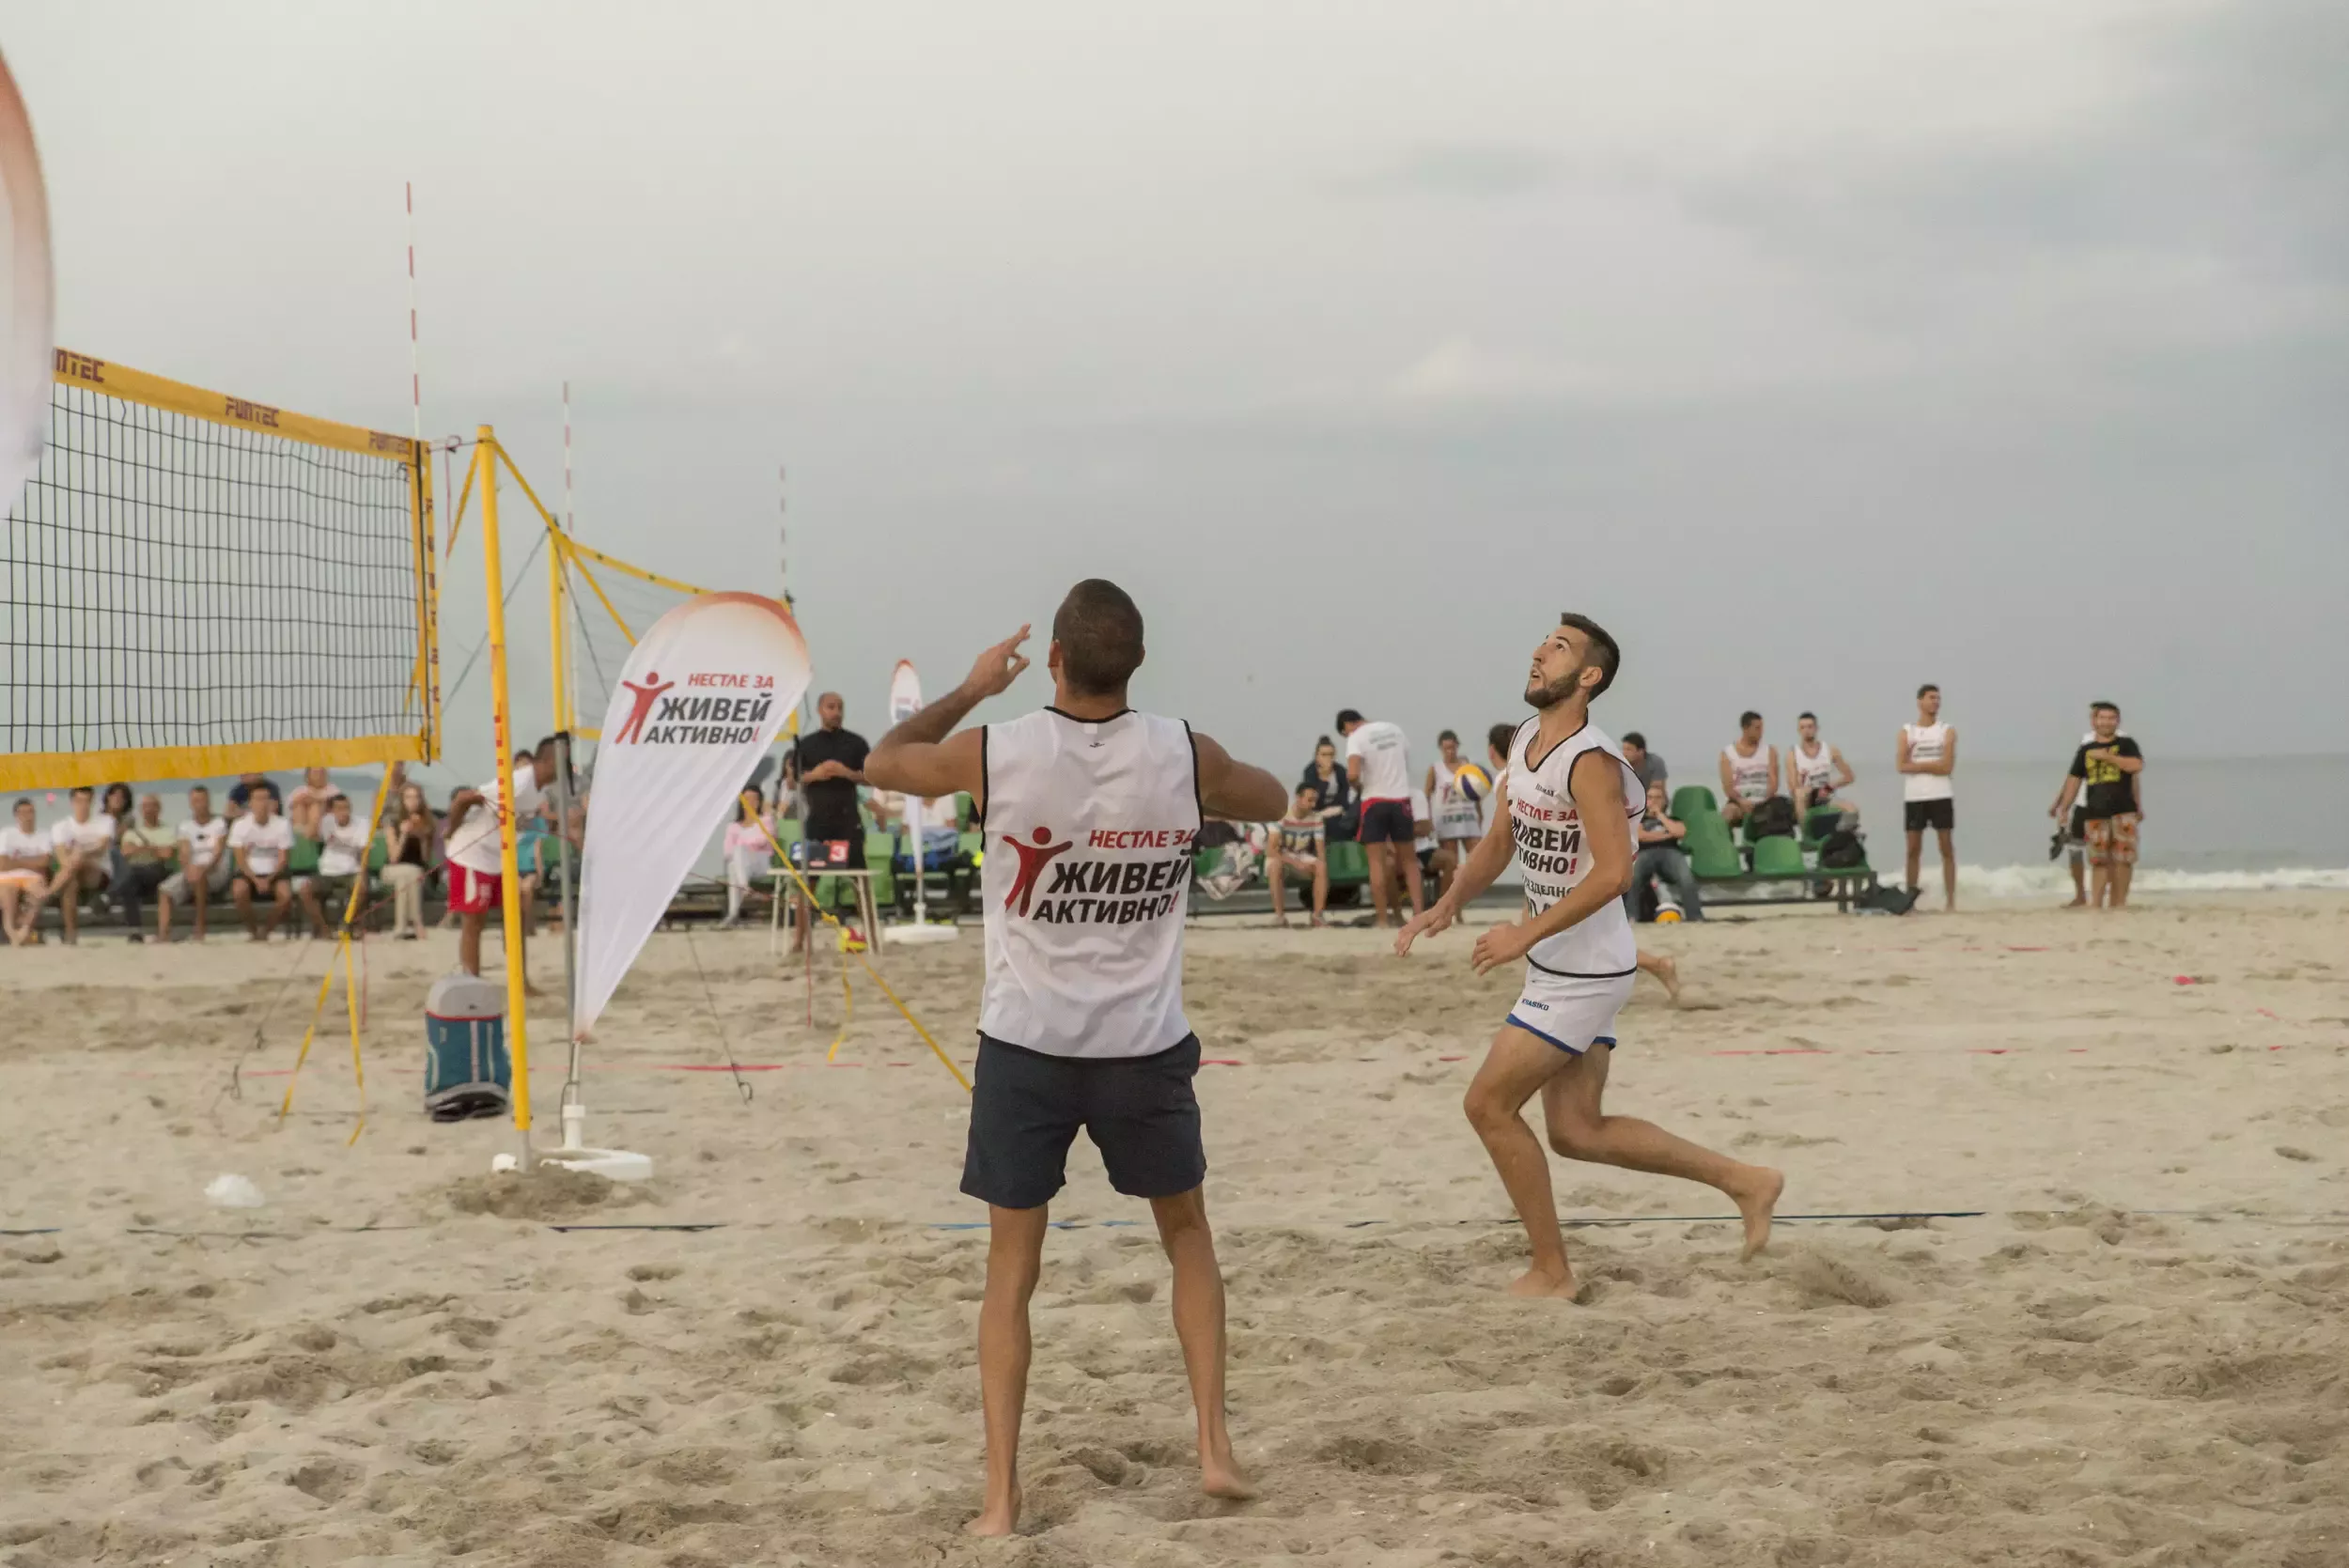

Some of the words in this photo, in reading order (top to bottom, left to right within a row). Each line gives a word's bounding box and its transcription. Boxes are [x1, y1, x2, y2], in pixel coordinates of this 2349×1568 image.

[56, 349, 105, 384] NTEC
[226, 396, 279, 428] FUNTEC
[687, 673, 748, 688] НЕСТЛЕ
[753, 675, 774, 689] ЗА
[657, 692, 772, 722] ЖИВЕЙ
[644, 725, 760, 744] АКТИВНО!
[1517, 797, 1553, 821] НЕСТЛЕ
[1557, 809, 1579, 821] ЗА
[1088, 829, 1169, 849] НЕСТЛЕ
[1047, 848, 1191, 893] ЖИВЕЙ
[1517, 844, 1578, 876] ТИВНО!
[1033, 890, 1180, 924] АКТИВНО!
